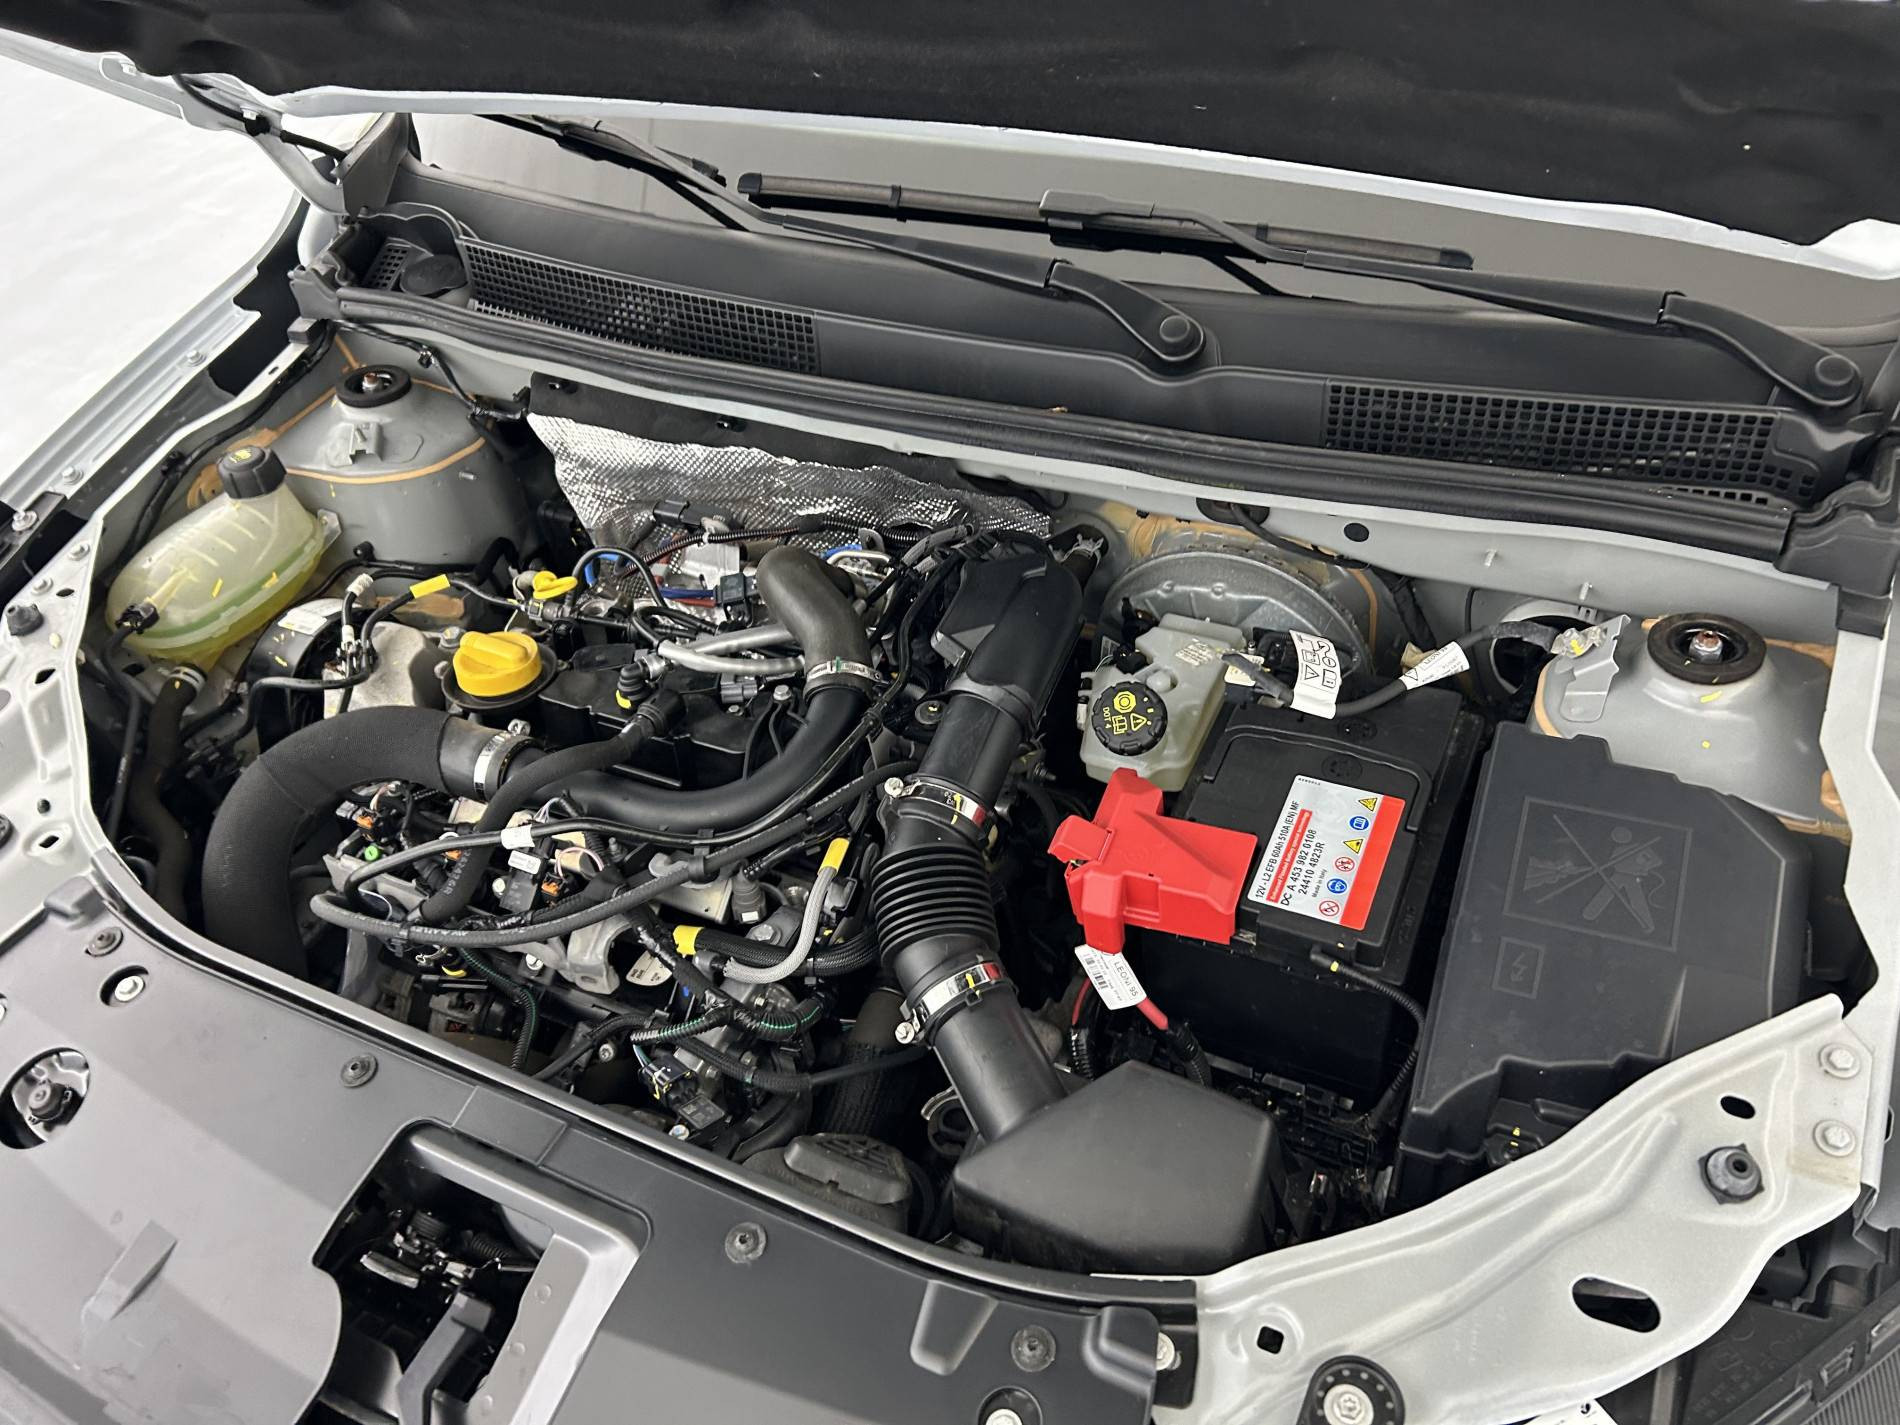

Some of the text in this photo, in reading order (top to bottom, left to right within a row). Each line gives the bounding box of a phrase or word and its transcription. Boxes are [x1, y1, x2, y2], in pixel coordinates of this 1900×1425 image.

[1102, 706, 1110, 721] DOT
[1289, 800, 1300, 811] MF
[1284, 810, 1297, 826] (EN)
[1278, 824, 1290, 841] 510A
[1271, 841, 1284, 858] 60Ah
[1266, 858, 1277, 872] EFB
[1281, 829, 1316, 906] DC A 453 982 0108
[1298, 841, 1324, 895] 24410 4823R
[1262, 872, 1271, 882] L2
[1255, 885, 1266, 898] 12V
[1114, 961, 1138, 997] LEONI 95
